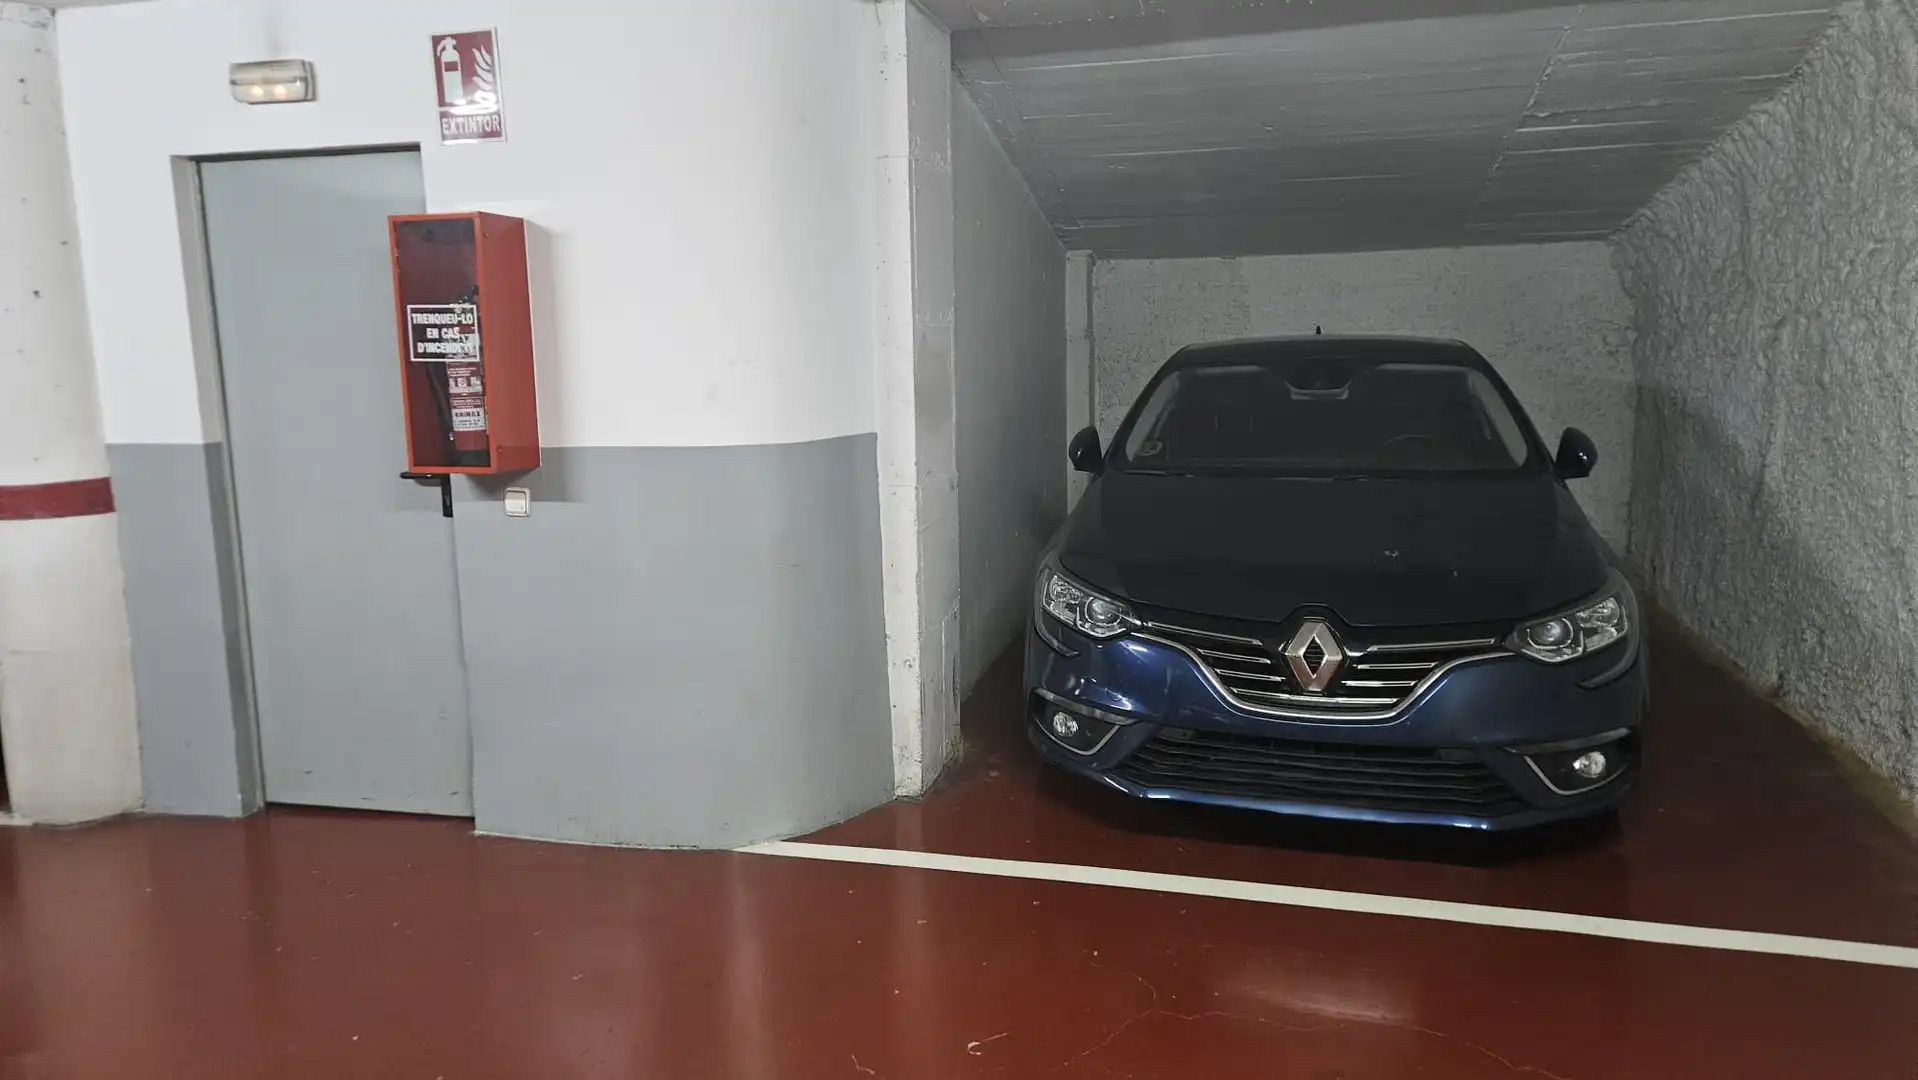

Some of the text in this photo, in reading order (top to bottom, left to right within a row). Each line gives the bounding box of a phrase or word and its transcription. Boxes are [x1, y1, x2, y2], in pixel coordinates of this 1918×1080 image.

[441, 115, 500, 135] EXTINTOR
[411, 313, 474, 325] TRENQUEU-LO
[426, 327, 460, 339] EN CAS
